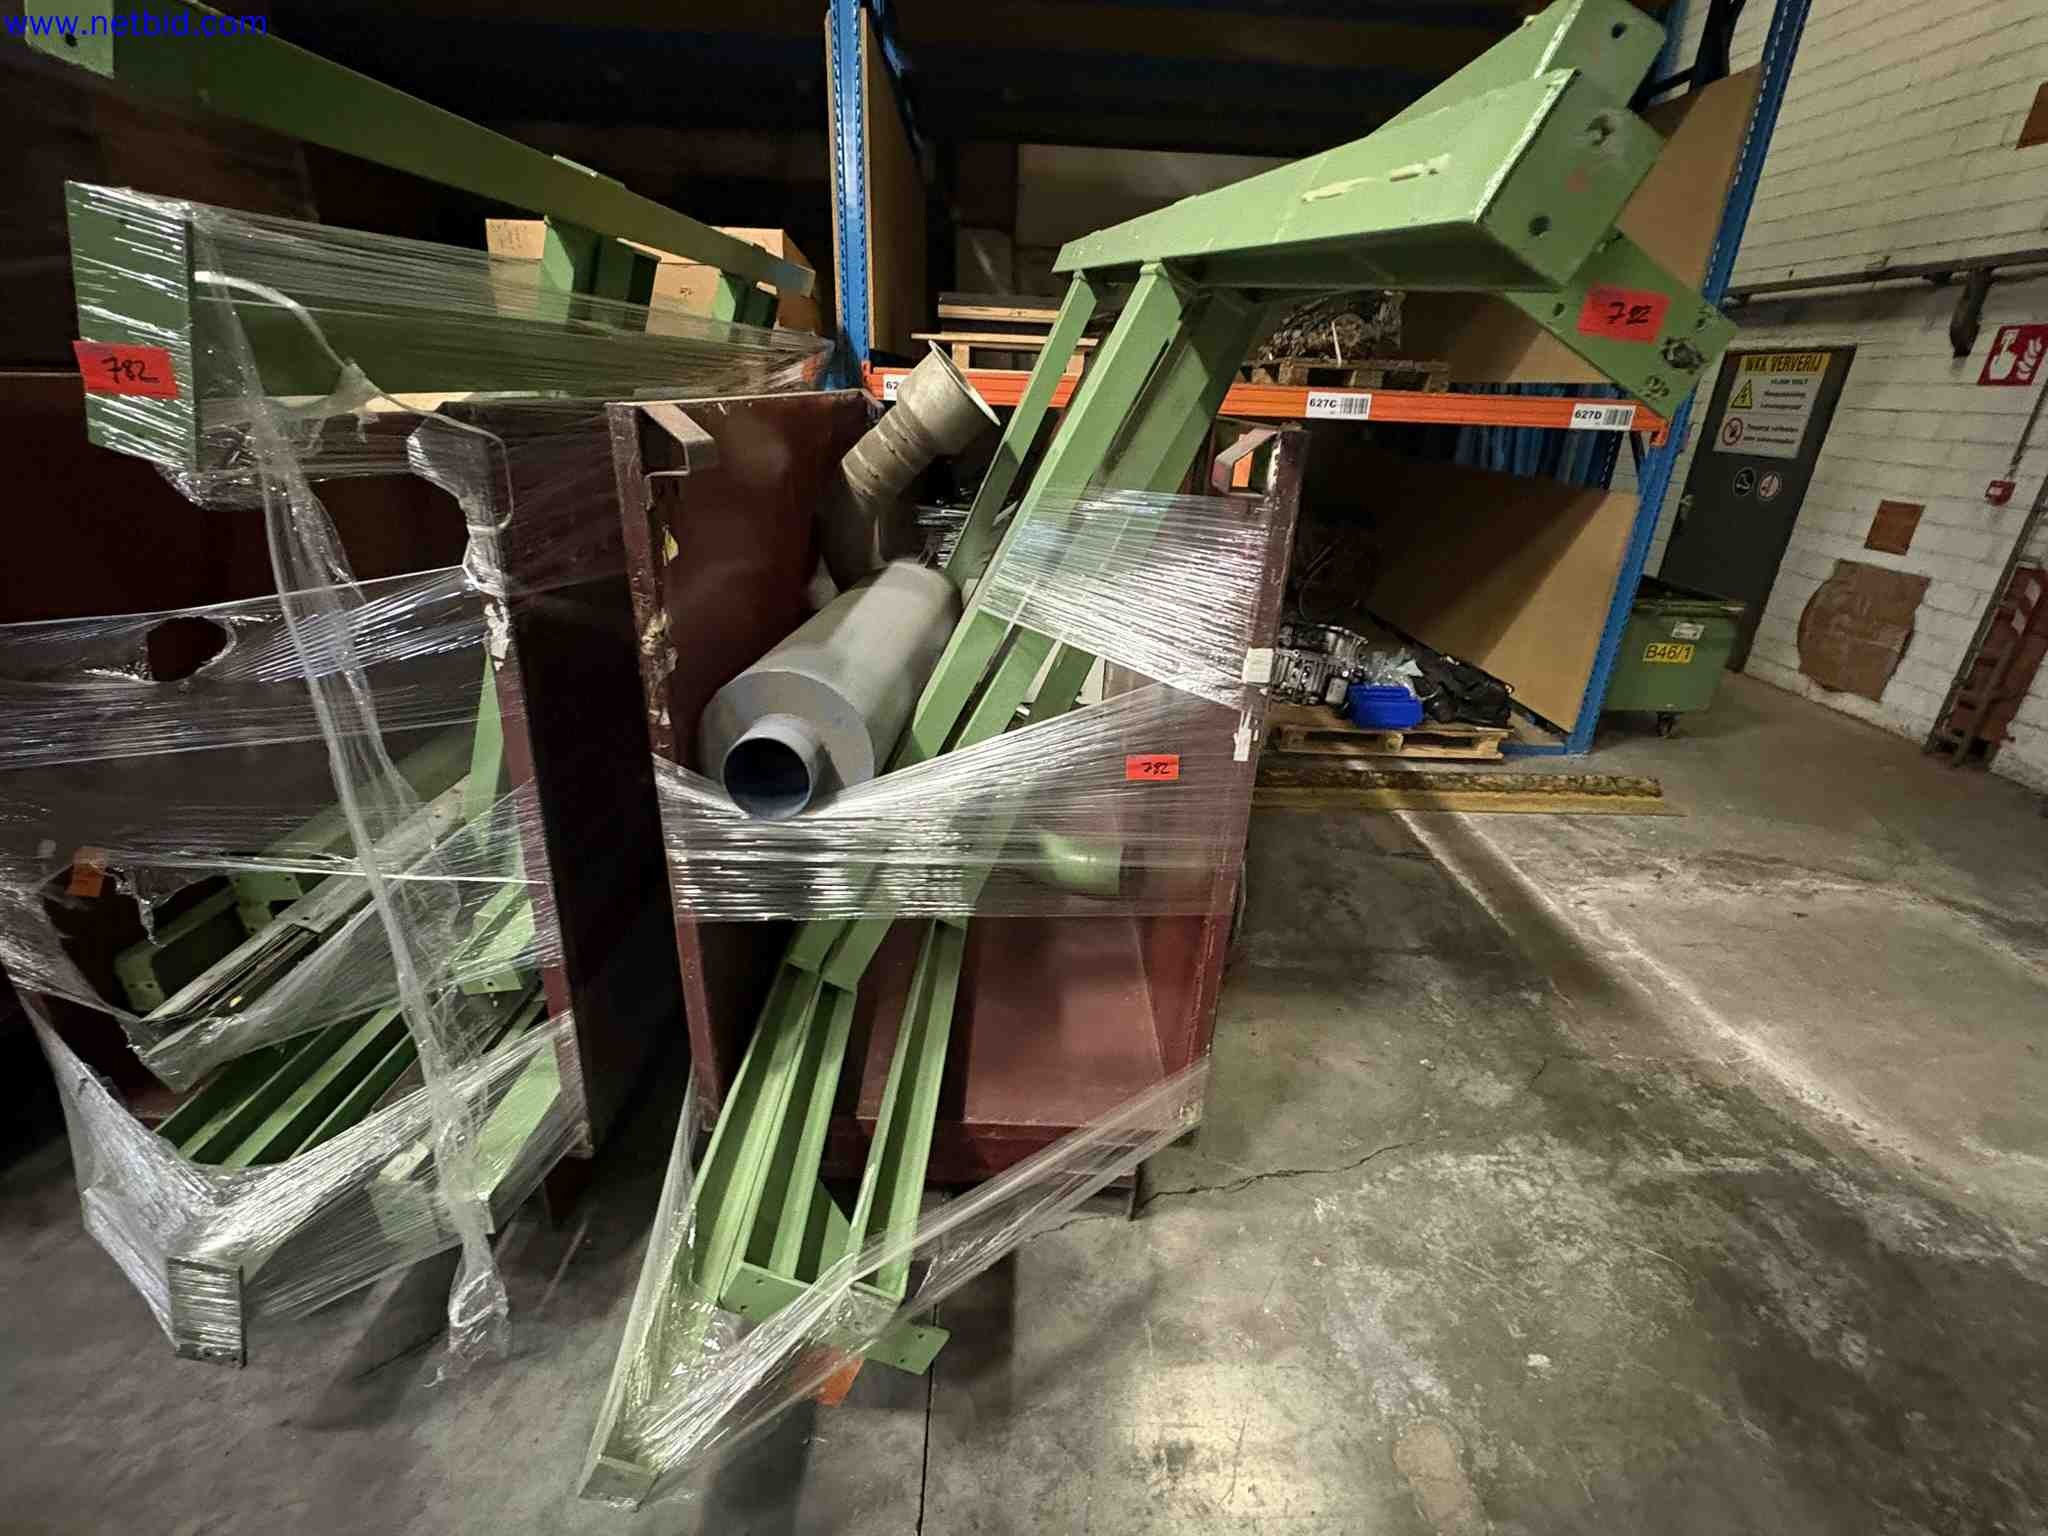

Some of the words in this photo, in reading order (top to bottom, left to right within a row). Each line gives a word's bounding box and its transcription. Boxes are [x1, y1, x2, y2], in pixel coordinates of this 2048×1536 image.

[101, 356, 159, 385] 782
[1309, 398, 1337, 409] 627C
[1575, 409, 1603, 420] 627D
